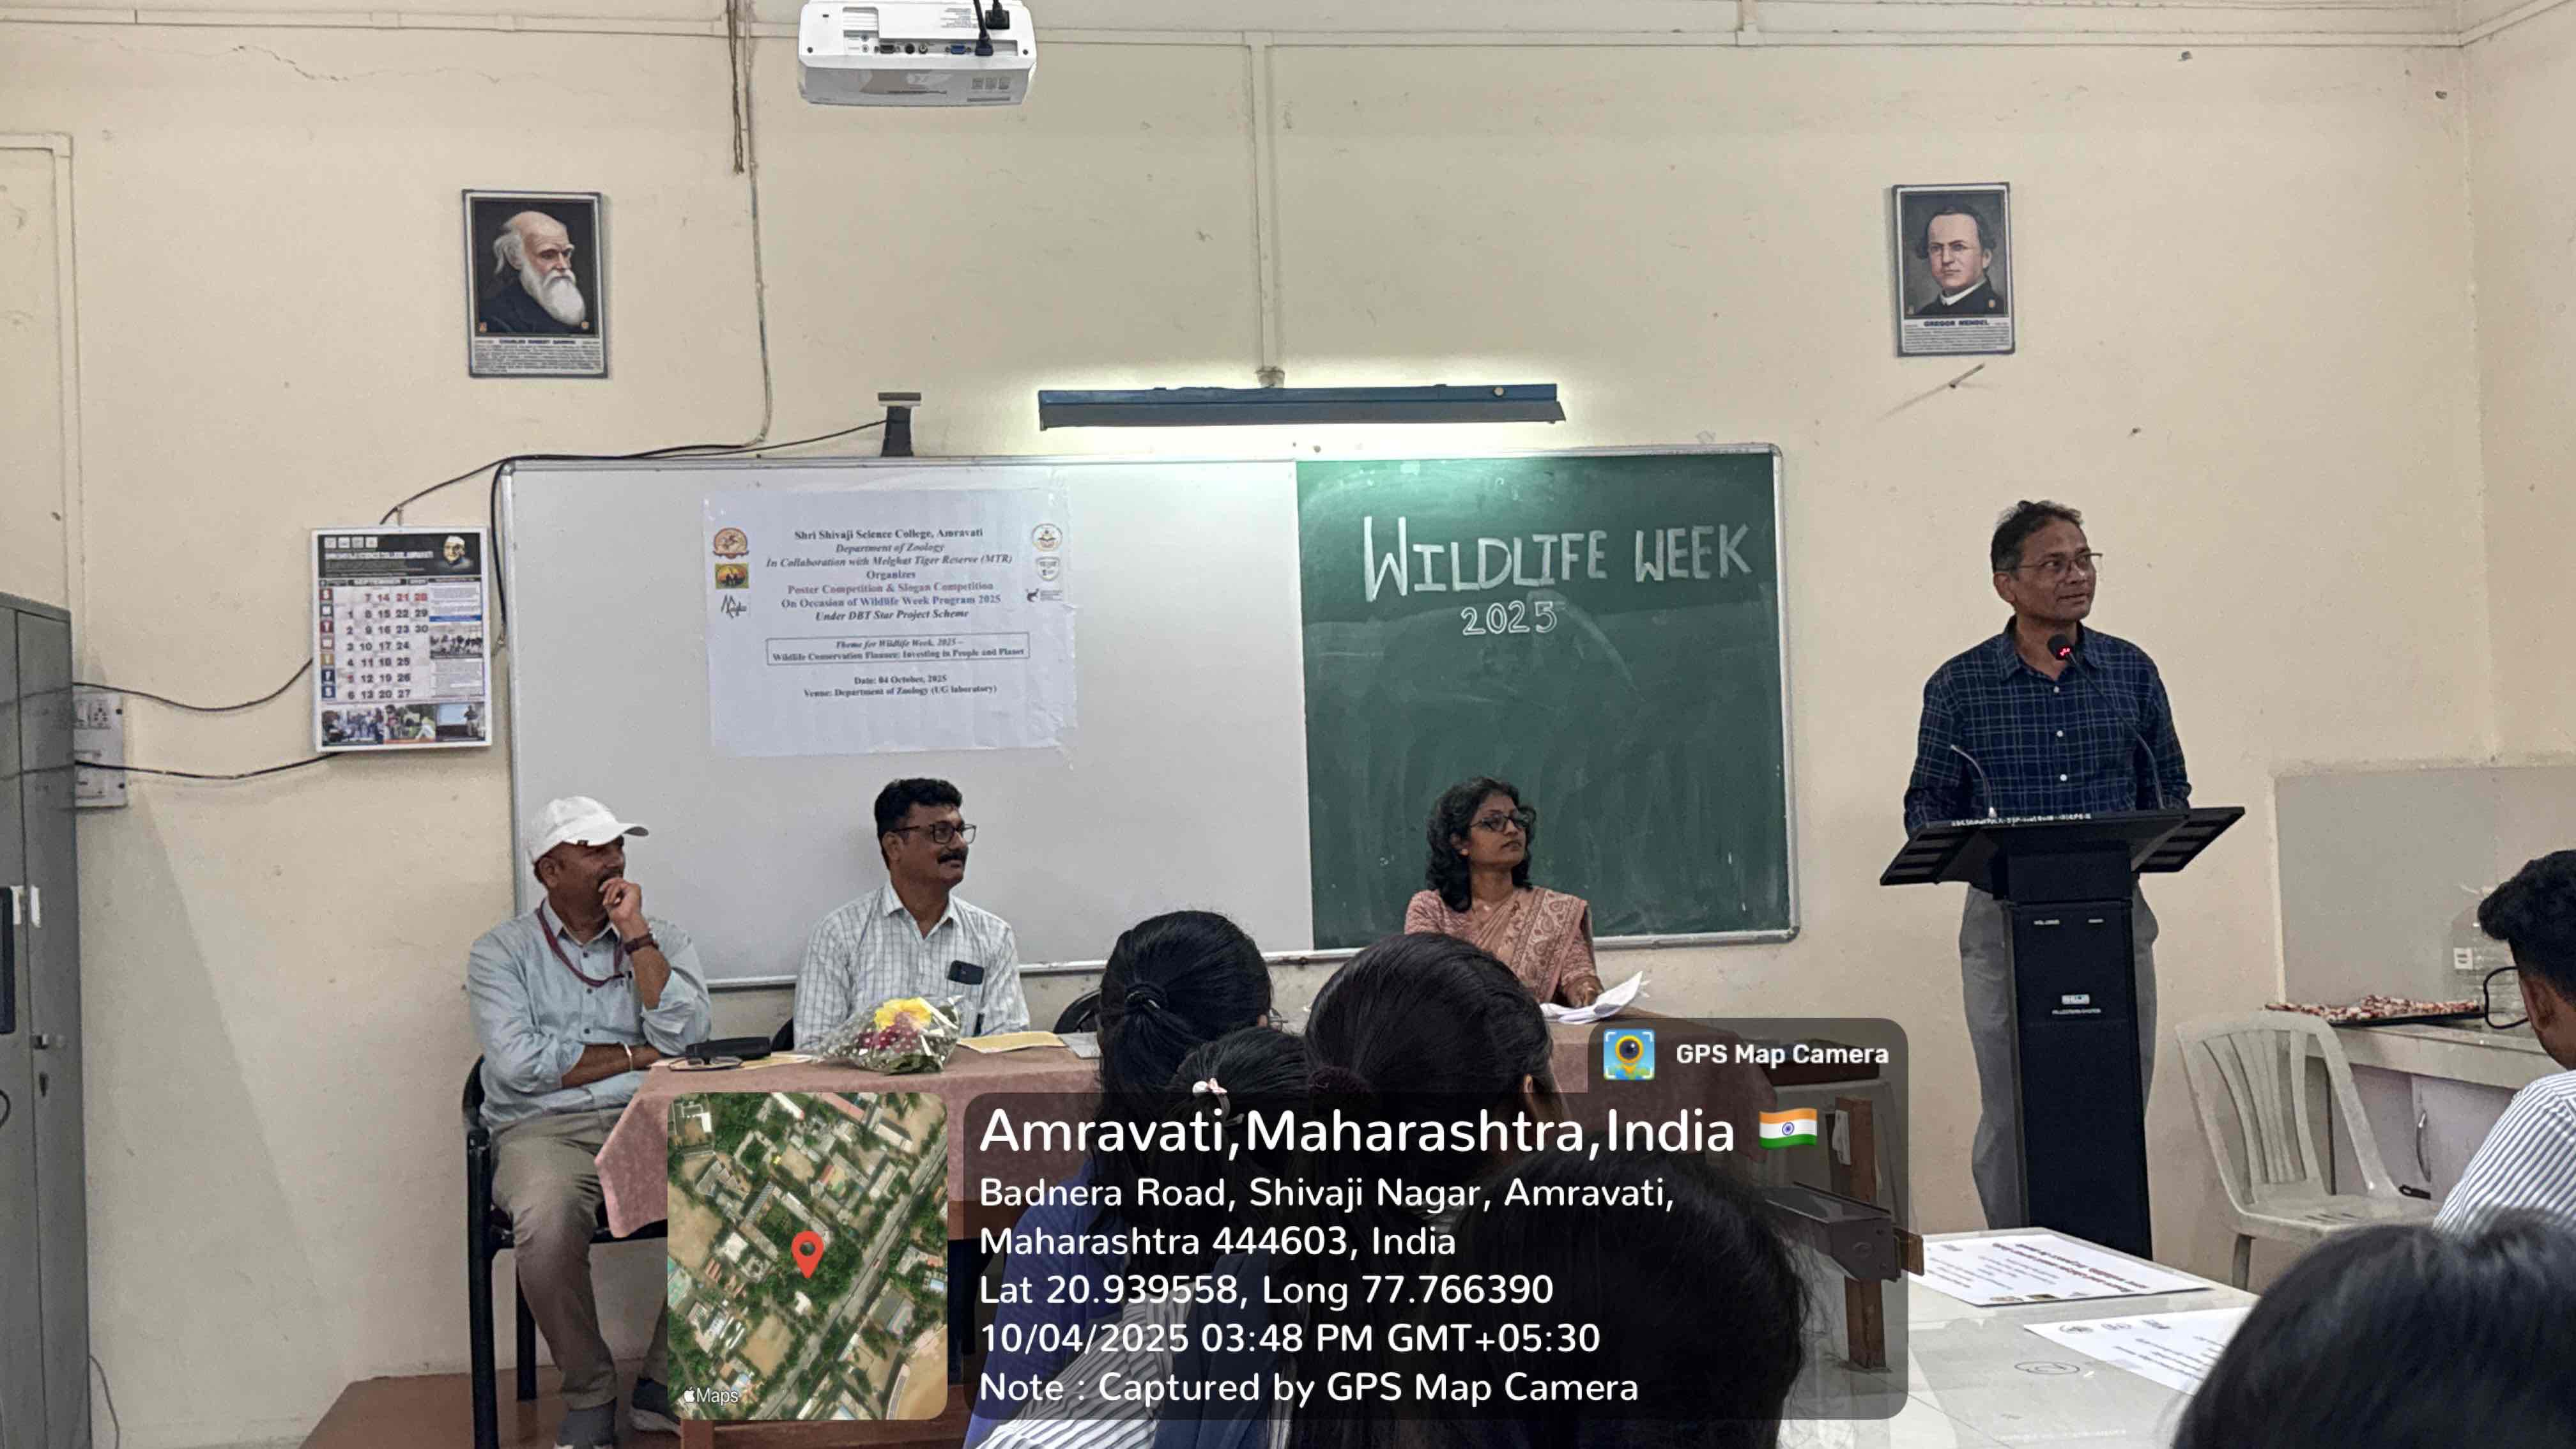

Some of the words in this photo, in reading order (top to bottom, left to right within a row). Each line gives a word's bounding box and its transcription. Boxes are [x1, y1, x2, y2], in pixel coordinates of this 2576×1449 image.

[794, 530, 816, 540] Shri
[818, 530, 854, 541] Shivaji
[856, 529, 892, 539] Science
[895, 528, 934, 540] College,
[937, 528, 983, 537] Amravati
[836, 543, 892, 555] Department
[894, 543, 905, 554] of
[907, 542, 944, 553] Zoology
[767, 558, 777, 567] In
[781, 557, 846, 567] Collaboration
[849, 556, 869, 565] with
[915, 555, 939, 566] Tiger
[942, 555, 978, 564] Reserve
[981, 553, 1013, 564] (MTR)
[1364, 516, 1607, 602] WILDLIFE
[1635, 523, 1752, 583] WEEK
[866, 570, 916, 581] Organizes
[788, 585, 819, 594] Poster
[822, 583, 882, 595] Competition
[886, 583, 894, 592] &
[898, 583, 931, 593] Slogan
[933, 581, 993, 592] Competition
[781, 599, 797, 608] On
[800, 598, 844, 608] Occasion
[847, 597, 857, 606] of
[859, 596, 899, 606] Wildlife
[901, 595, 930, 605] Week
[933, 595, 975, 606] Program
[979, 594, 1001, 604] 2025
[816, 611, 846, 621] Under
[848, 611, 871, 620] DBT
[873, 610, 894, 620] Star
[896, 609, 930, 621] Project
[932, 608, 969, 618] Scheme
[1460, 600, 1557, 635] 2025
[854, 676, 876, 685] Date:
[891, 675, 926, 684] October,
[928, 675, 947, 683] 2025
[804, 689, 831, 697] Venue:
[834, 688, 884, 698] Department
[896, 686, 928, 696] Zoology
[951, 685, 997, 694] laboratory)
